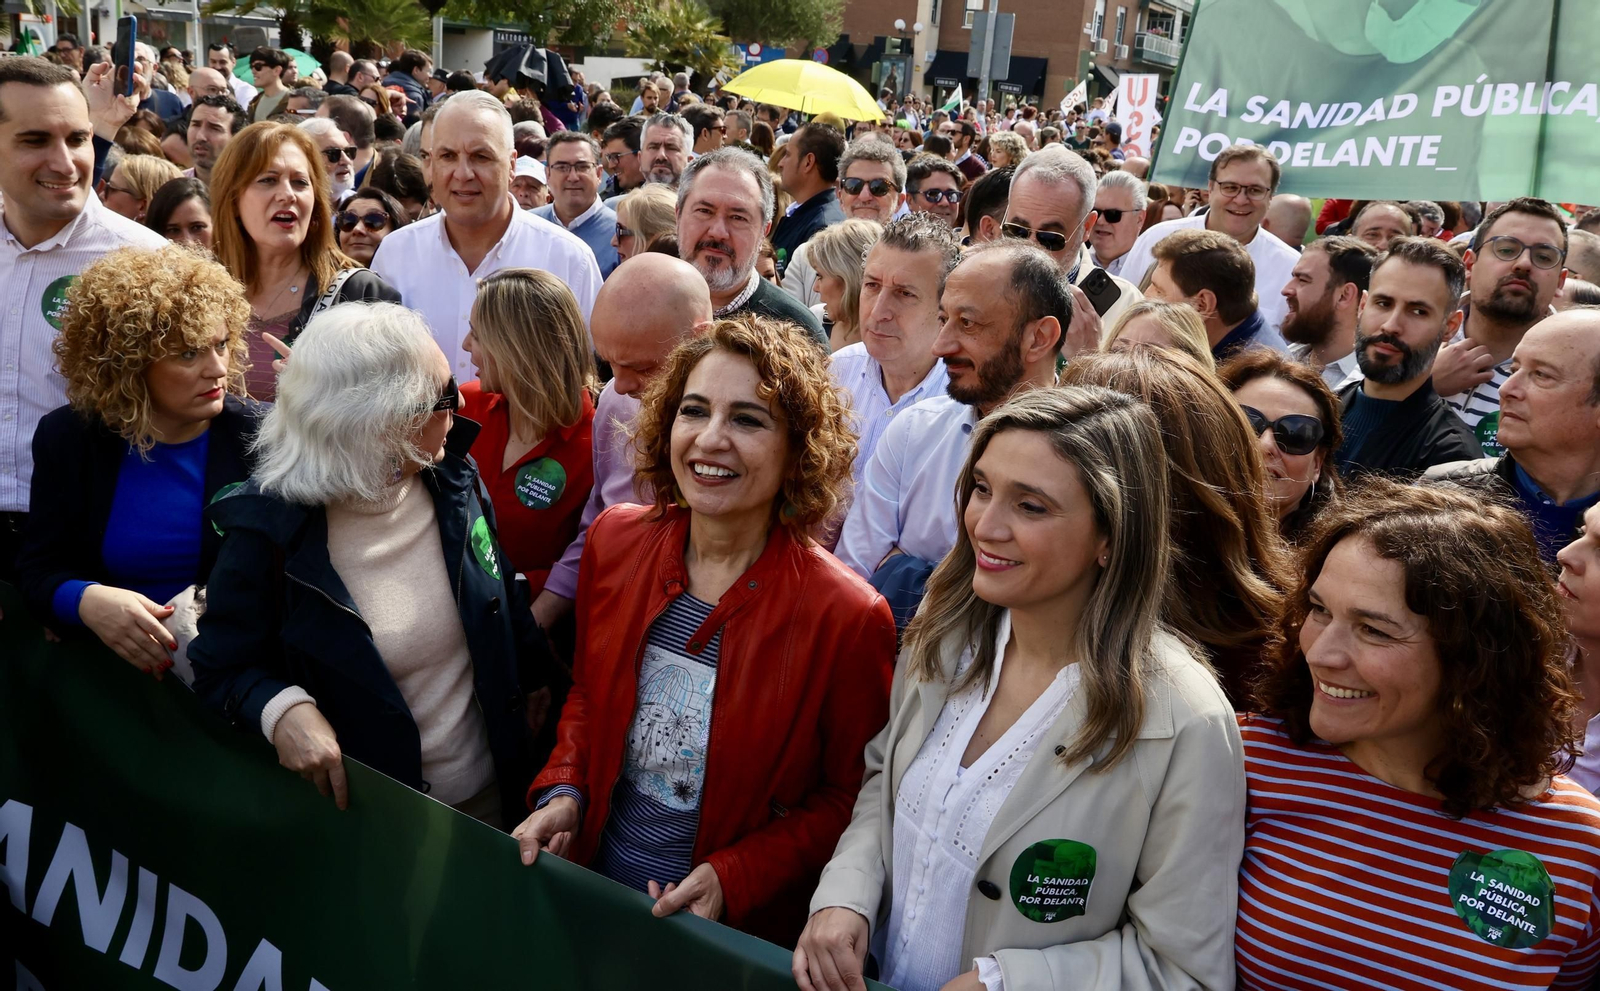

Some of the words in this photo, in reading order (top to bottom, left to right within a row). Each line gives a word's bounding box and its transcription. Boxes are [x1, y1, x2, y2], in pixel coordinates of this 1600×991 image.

[497, 33, 522, 42] TATTOO
[1184, 82, 1228, 117] LA
[1240, 93, 1419, 129] SANIDAD
[47, 310, 62, 318] POR
[517, 485, 529, 494] POR
[532, 477, 556, 491] SANIDAD
[1026, 874, 1040, 883] LA
[1042, 877, 1089, 885] SANIDAD
[1035, 886, 1078, 896] PÚBLICA,
[1469, 871, 1485, 884] LA
[1488, 878, 1541, 907] SANIDAD
[1019, 895, 1041, 905] POR
[1458, 893, 1485, 911] POR
[1478, 888, 1528, 917] PÚBLICA,
